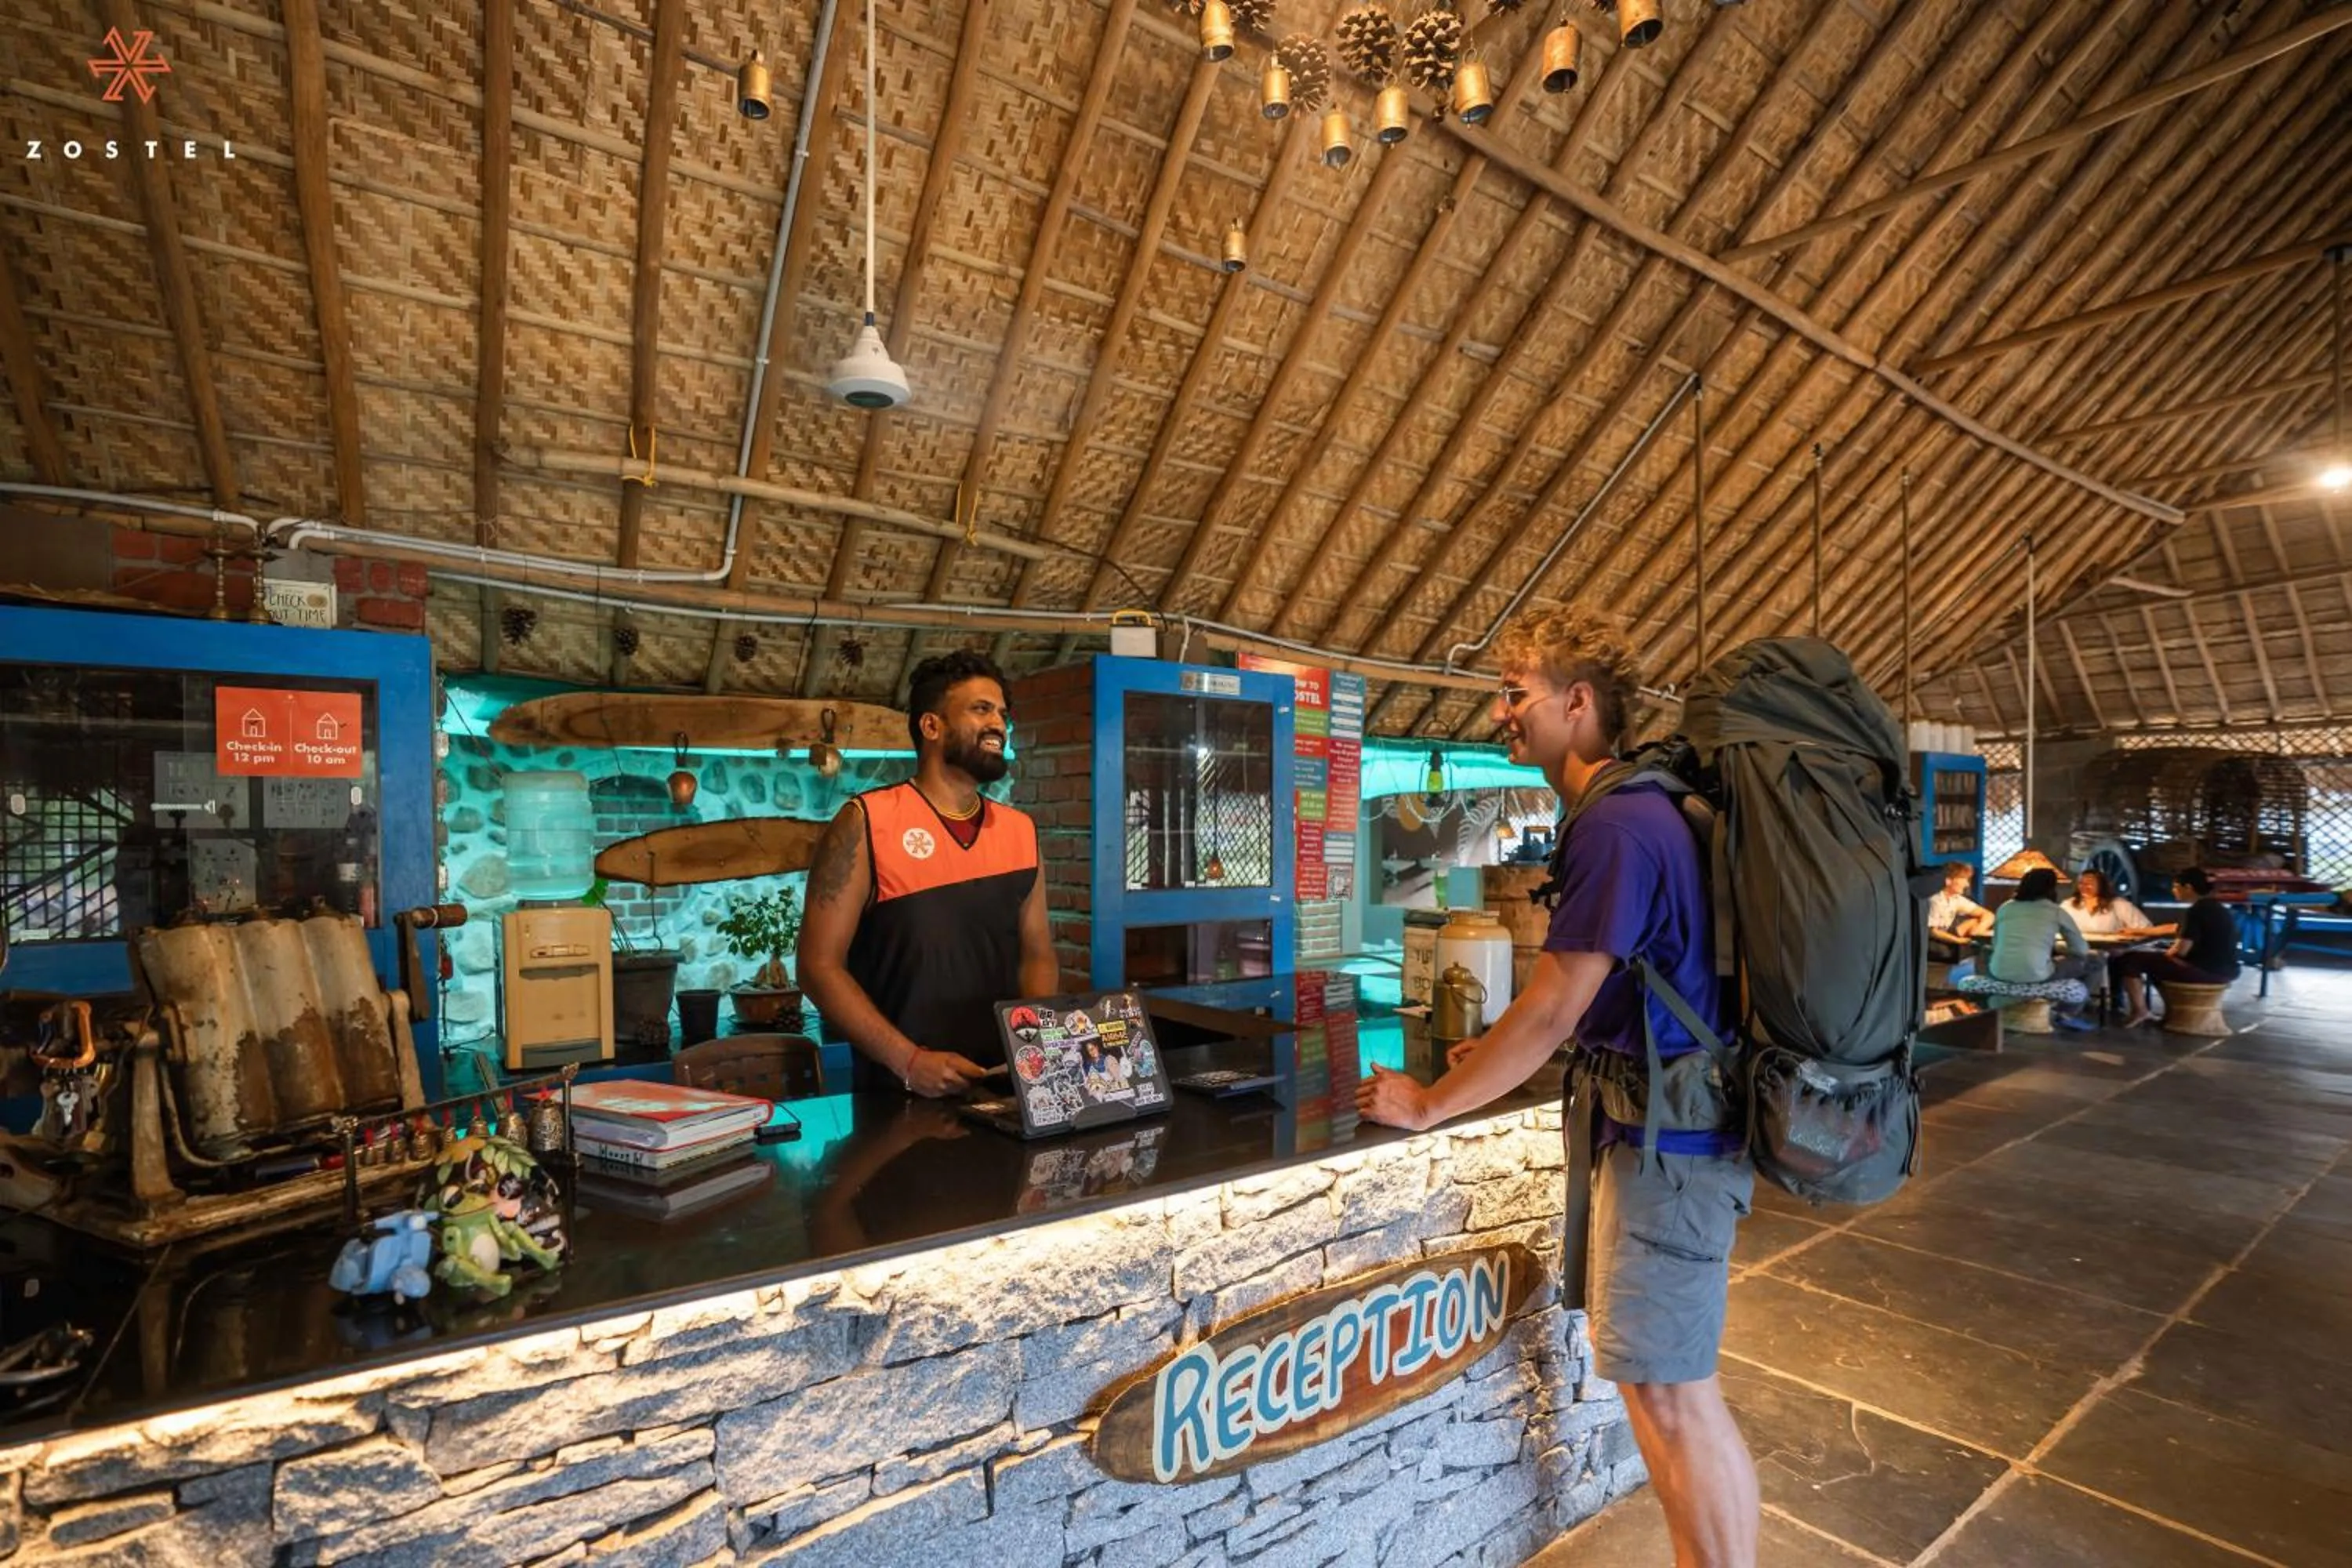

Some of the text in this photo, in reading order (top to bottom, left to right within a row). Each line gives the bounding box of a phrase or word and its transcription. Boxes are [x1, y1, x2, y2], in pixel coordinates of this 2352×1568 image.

[269, 593, 307, 608] CHECK
[299, 609, 326, 622] TIME
[226, 741, 282, 752] Check-in
[294, 742, 358, 754] Check-out
[234, 753, 275, 765] 12 pm
[307, 754, 321, 764] 10
[1154, 1251, 1509, 1483] RECEPTION
